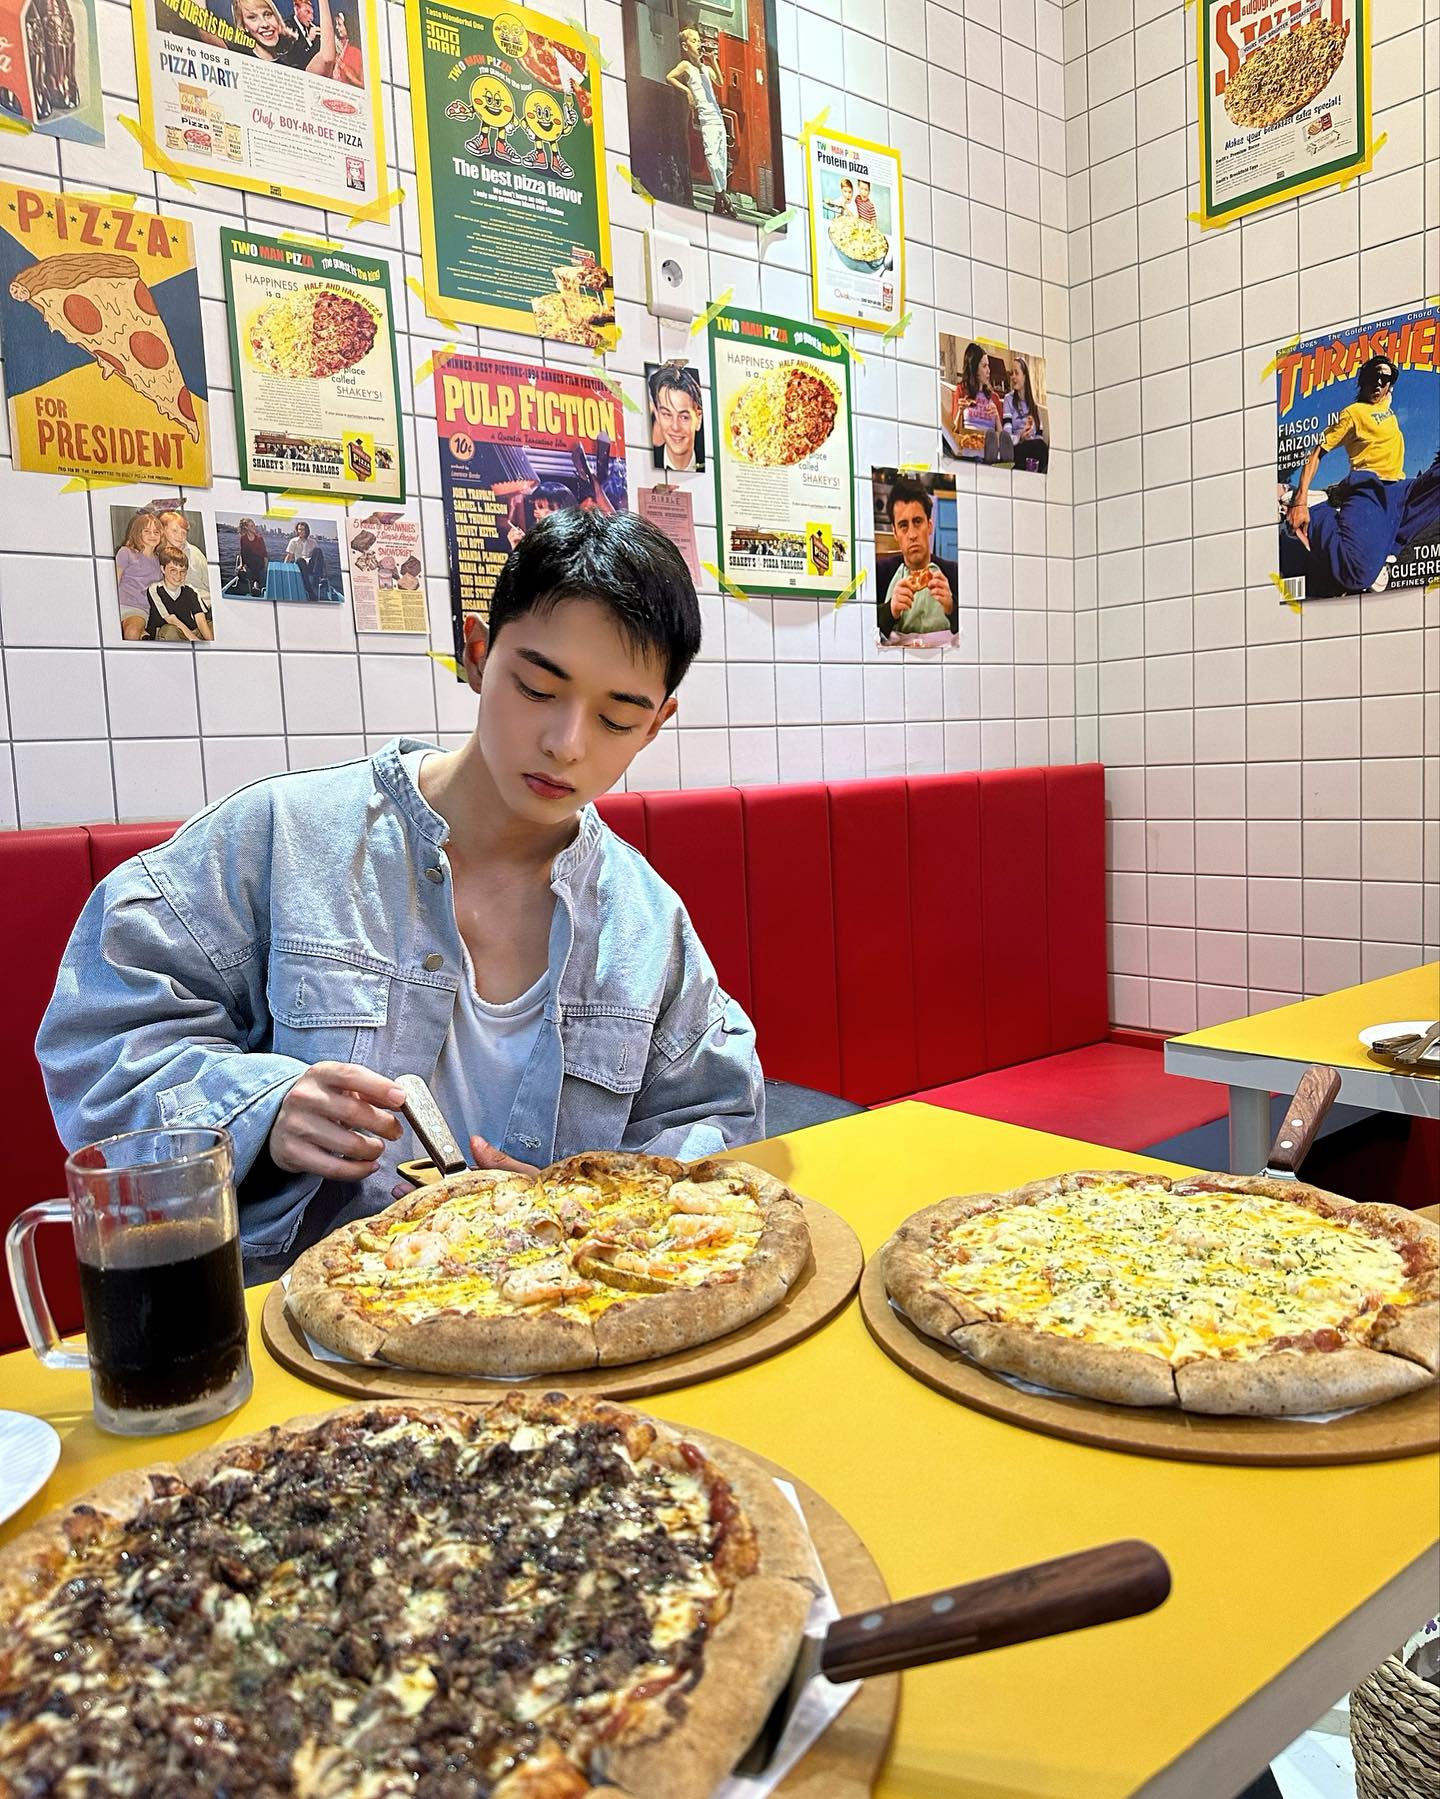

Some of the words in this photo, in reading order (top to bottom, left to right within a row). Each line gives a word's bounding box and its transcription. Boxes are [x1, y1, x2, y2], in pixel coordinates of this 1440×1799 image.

[425, 7, 441, 17] Taste
[473, 20, 484, 30] One
[1243, 41, 1257, 52] YOURS
[1268, 22, 1289, 38] BRIGHTER
[1290, 3, 1317, 23] BREAKFASTS
[207, 15, 218, 35] is
[218, 18, 234, 42] the
[235, 28, 257, 49] king
[426, 19, 460, 45] TWO
[163, 39, 184, 53] How
[187, 45, 197, 57] to
[200, 49, 221, 63] toss
[224, 57, 231, 66] a
[427, 36, 460, 58] MAN
[160, 52, 197, 80] PIZZA
[201, 63, 239, 89] PARTY
[448, 60, 466, 82] TWO
[486, 55, 512, 75] PIZZA
[252, 107, 276, 130] Chef
[279, 116, 335, 141] BOY-AR-DEE
[337, 131, 364, 149] PIZZA
[1225, 137, 1244, 150] Makes
[1246, 130, 1262, 142] your
[1264, 116, 1294, 135] breakfast
[1296, 108, 1312, 121] extra
[1314, 95, 1342, 114] special!
[817, 151, 848, 170] Protein
[849, 161, 869, 175] pizza
[1230, 149, 1247, 158] Premium
[452, 156, 479, 179] The
[481, 164, 512, 188] best
[514, 174, 545, 196] pizza
[546, 180, 583, 205] flavor
[16, 190, 172, 258] PIZZA
[231, 239, 258, 257] TWO
[259, 245, 285, 262] MAN
[286, 251, 315, 269] PIZZA
[322, 258, 333, 270] The
[357, 268, 367, 281] the
[245, 273, 299, 292] HAPPINESS
[265, 287, 272, 297] is
[304, 282, 323, 291] HALF
[325, 282, 341, 292] AND
[341, 285, 361, 300] HALF
[362, 297, 384, 319] PIZZA
[716, 317, 740, 334] TWO
[741, 320, 763, 338] MAN
[764, 325, 788, 343] PIZZA
[1300, 341, 1318, 349] Dogs
[1328, 334, 1341, 342] The
[1345, 324, 1372, 336] Golden
[1376, 319, 1396, 329] Hour
[1407, 309, 1432, 321] Chord
[727, 353, 774, 370] HAPPINESS
[745, 367, 751, 377] is
[332, 375, 356, 385] called
[566, 374, 579, 386] FILM
[779, 359, 795, 369] HALF
[797, 360, 808, 369] AND
[809, 364, 825, 377] HALF
[825, 376, 843, 396] PIZZA
[336, 386, 382, 399] SHAKEY'S!
[34, 396, 68, 419] FOR
[443, 374, 516, 428] PULP
[518, 384, 617, 443] FICTION
[1278, 416, 1319, 437] FIASCO
[1327, 411, 1341, 426] IN
[36, 419, 186, 470] PRESIDENT
[1278, 432, 1327, 454] ARIZONA
[252, 458, 284, 470] SHAKEY'S
[292, 461, 310, 473] PIZZA
[312, 464, 340, 475] PARLORS
[1278, 459, 1310, 471] EXPOSED
[1279, 453, 1291, 462] THE
[729, 556, 756, 567] SHAKEY'S
[763, 558, 779, 568] PIZZA
[781, 559, 804, 570] PARLORS
[1413, 544, 1440, 560] TOM
[1391, 578, 1425, 588] DEFINES
